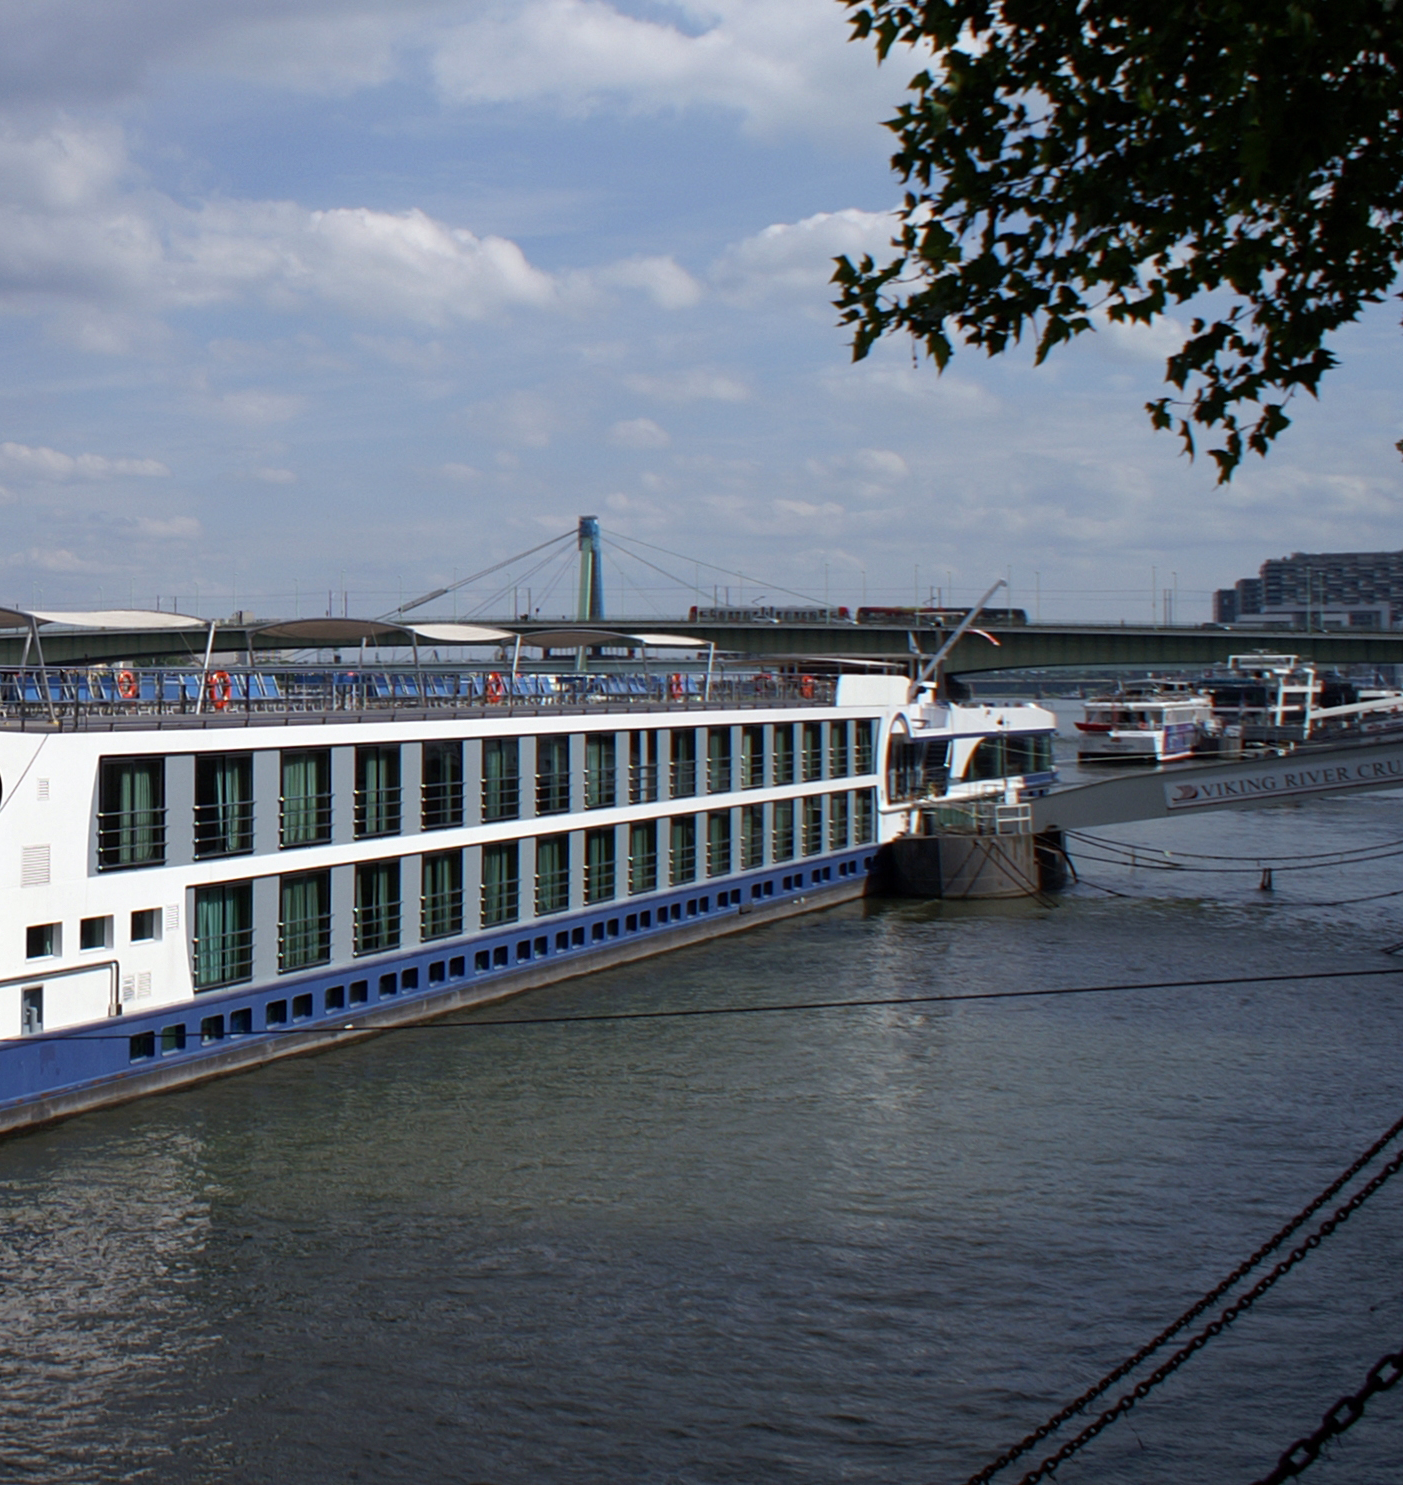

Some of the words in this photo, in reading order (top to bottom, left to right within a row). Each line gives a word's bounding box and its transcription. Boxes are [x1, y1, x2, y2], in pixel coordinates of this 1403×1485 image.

[1200, 775, 1276, 798] VIKING
[1283, 766, 1350, 789] RIVER
[1356, 759, 1402, 779] CRU
